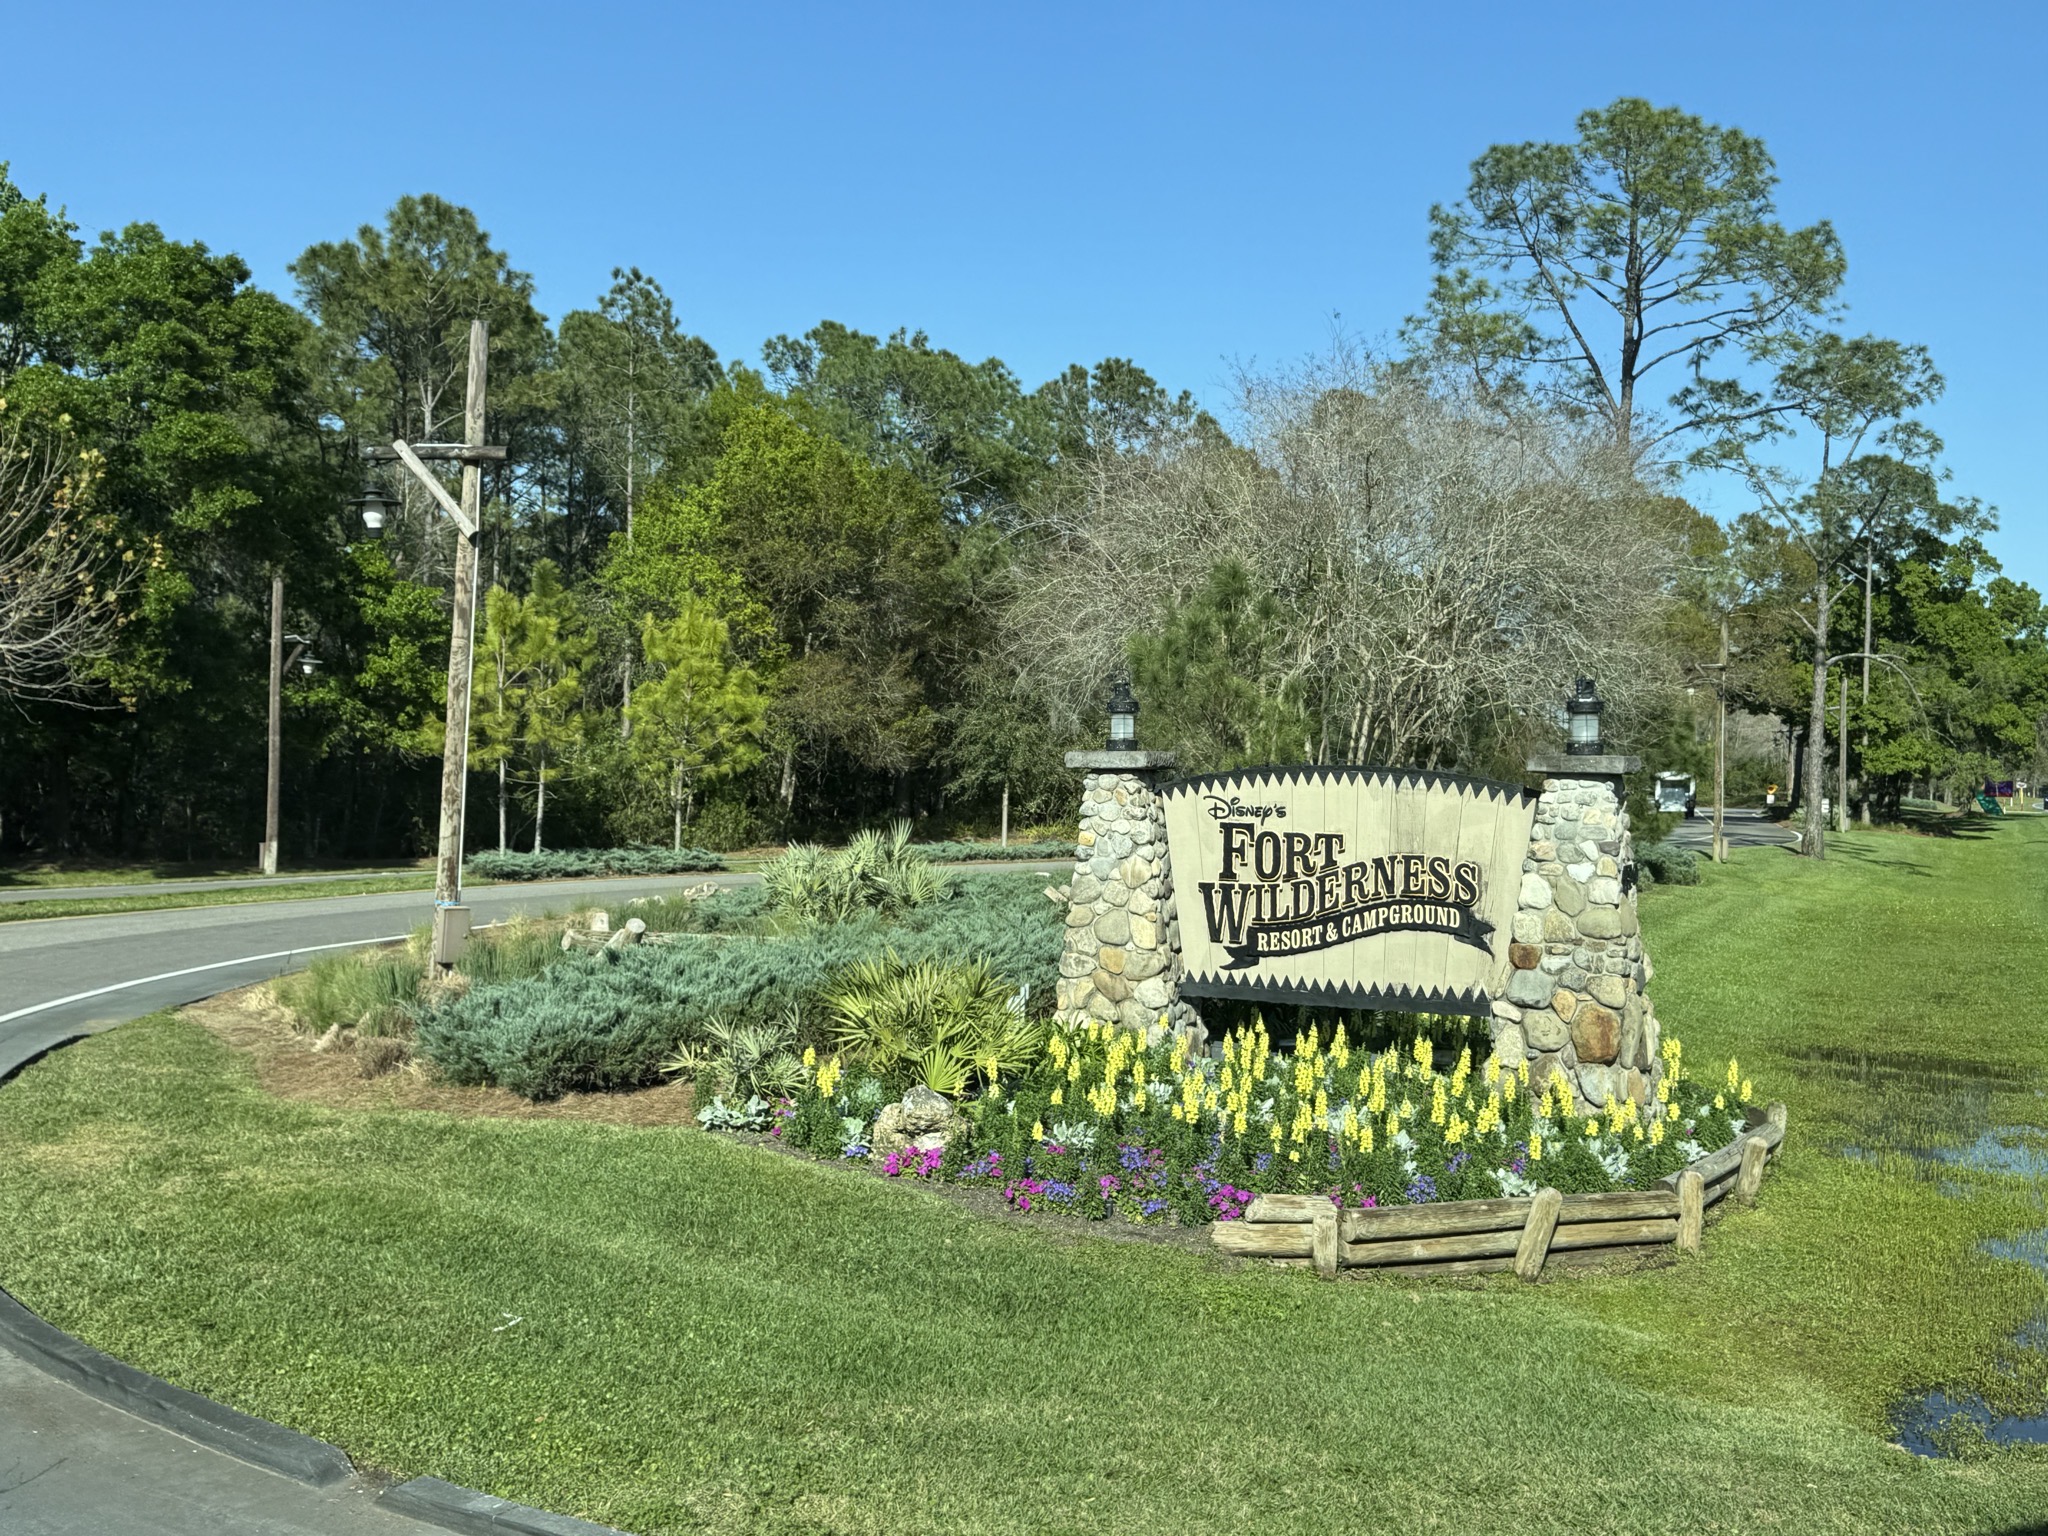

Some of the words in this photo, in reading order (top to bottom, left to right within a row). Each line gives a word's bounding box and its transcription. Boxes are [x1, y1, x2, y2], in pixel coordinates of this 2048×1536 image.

[1219, 822, 1345, 882] FORT
[1198, 855, 1479, 944] WILDERNESS
[1257, 926, 1323, 952] RESORT
[1325, 924, 1339, 942] &
[1342, 905, 1461, 937] CAMPGROUND
